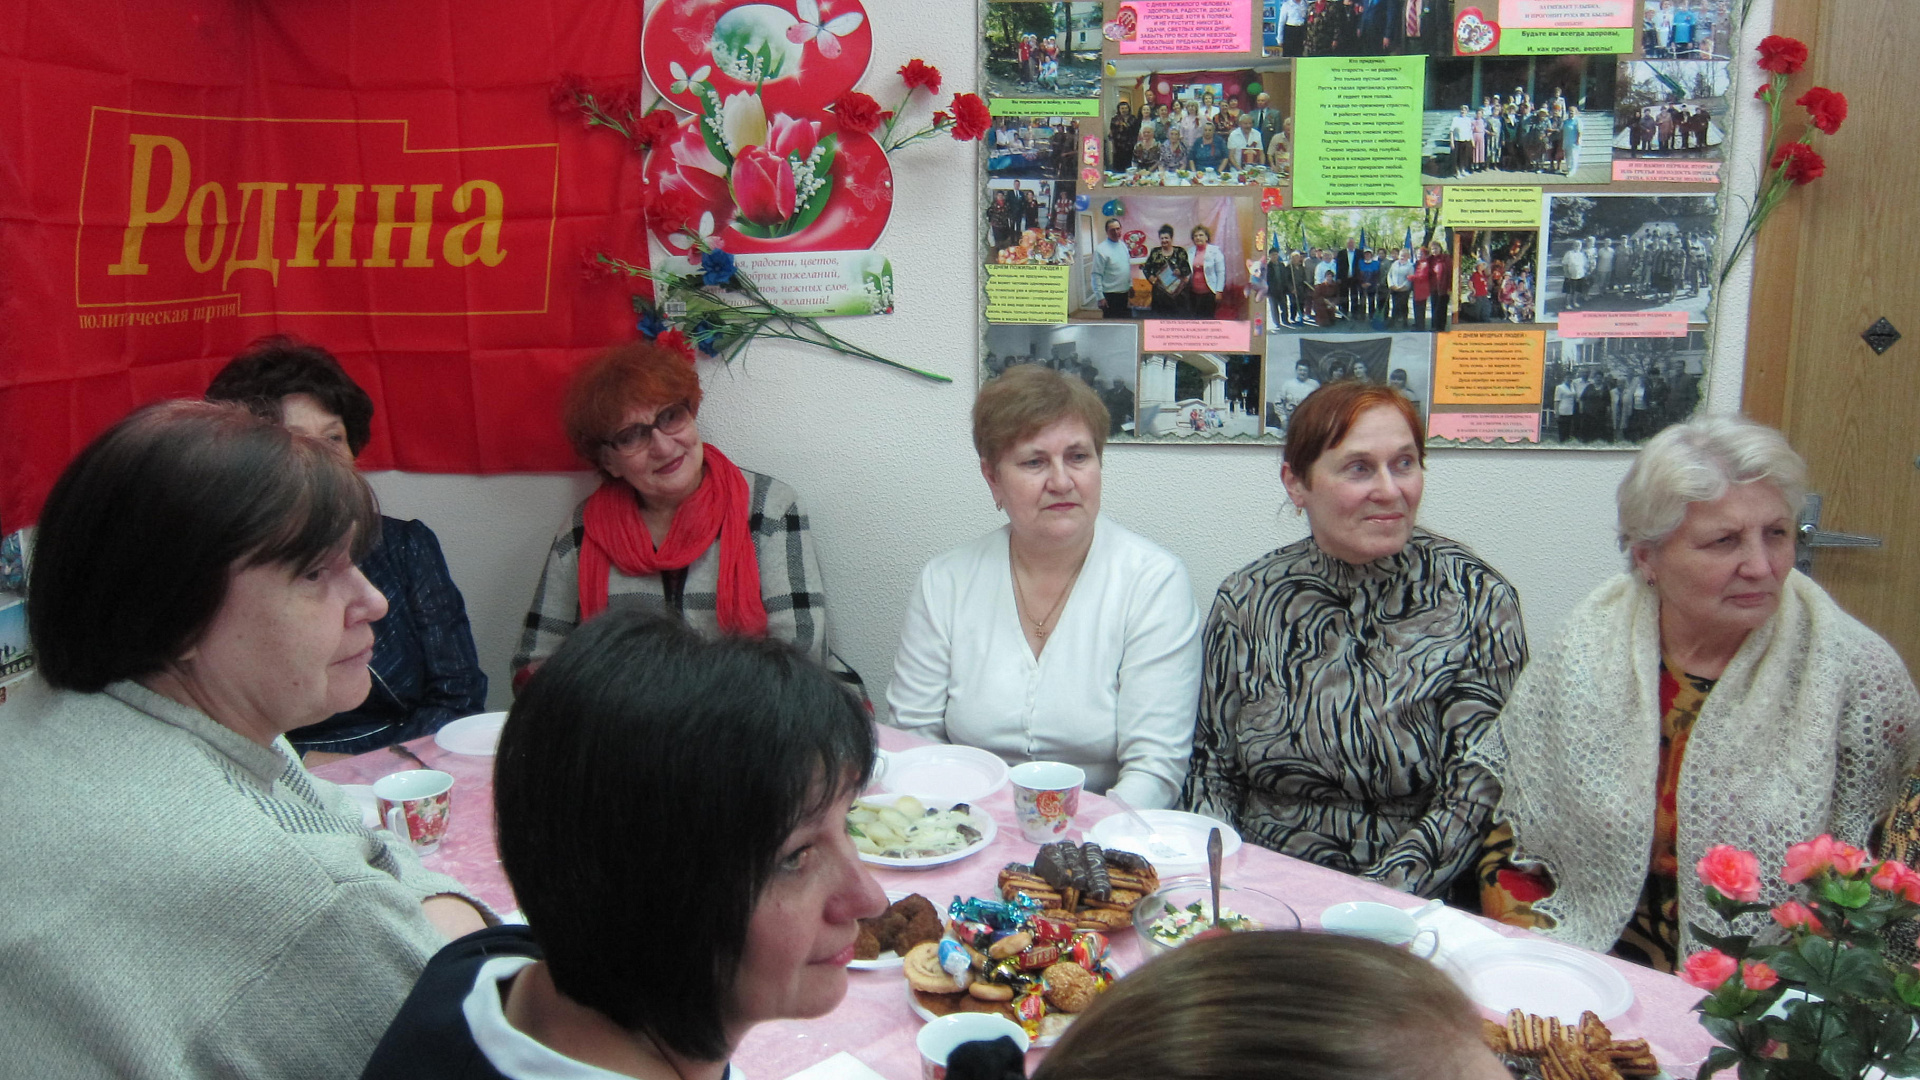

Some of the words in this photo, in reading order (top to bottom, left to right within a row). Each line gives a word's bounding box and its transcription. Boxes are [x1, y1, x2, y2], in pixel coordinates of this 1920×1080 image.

[107, 133, 507, 291] Родина
[751, 257, 797, 269] радости,
[800, 257, 839, 268] цветов,
[780, 270, 840, 280] пожеланий,
[781, 284, 822, 293] нежных
[825, 283, 849, 293] слов,
[781, 295, 830, 305] желаний!
[79, 309, 189, 329] политическая
